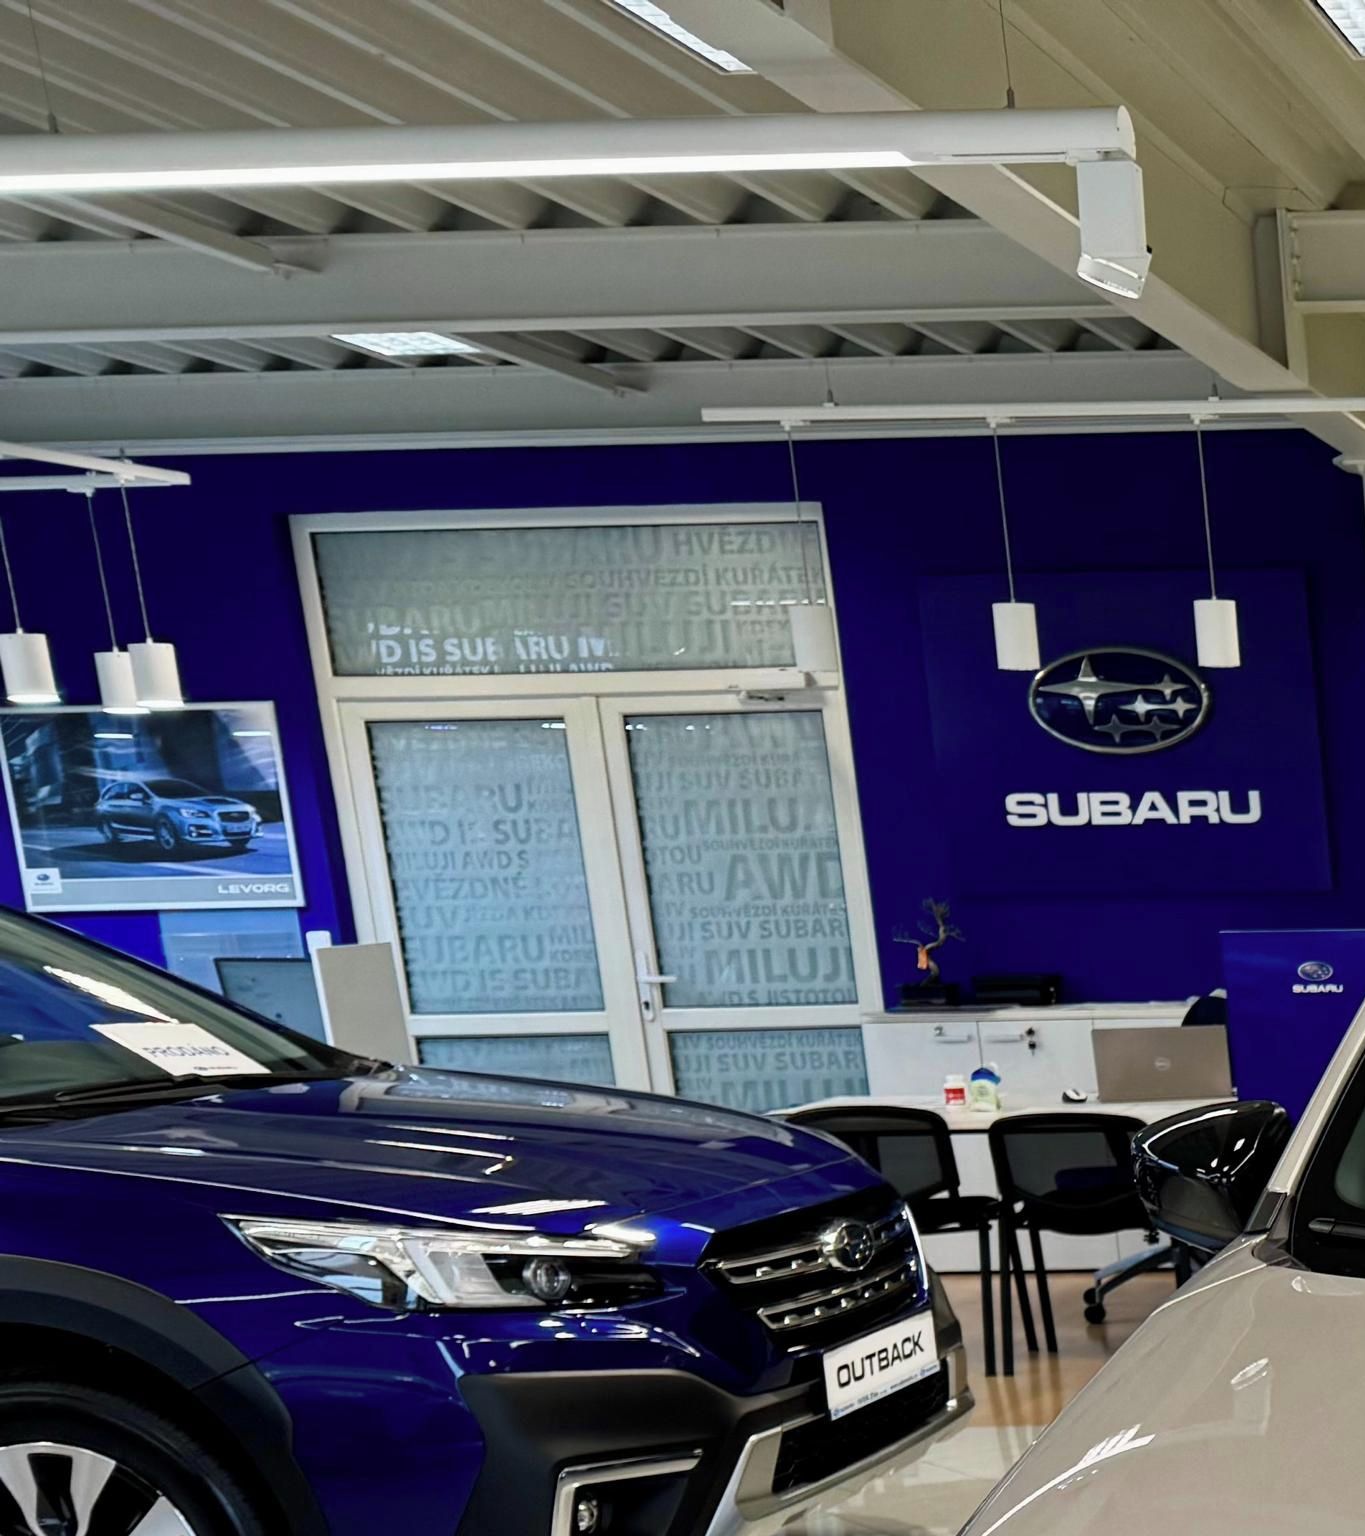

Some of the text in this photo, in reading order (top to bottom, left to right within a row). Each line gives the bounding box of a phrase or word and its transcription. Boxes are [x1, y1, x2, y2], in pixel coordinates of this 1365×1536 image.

[1005, 790, 1261, 827] SUBARU
[218, 883, 290, 894] LEVORG
[701, 918, 751, 941] SUV
[1292, 984, 1343, 994] SUBARU
[718, 1053, 768, 1073] SUV
[837, 1330, 924, 1389] OUTBACK
